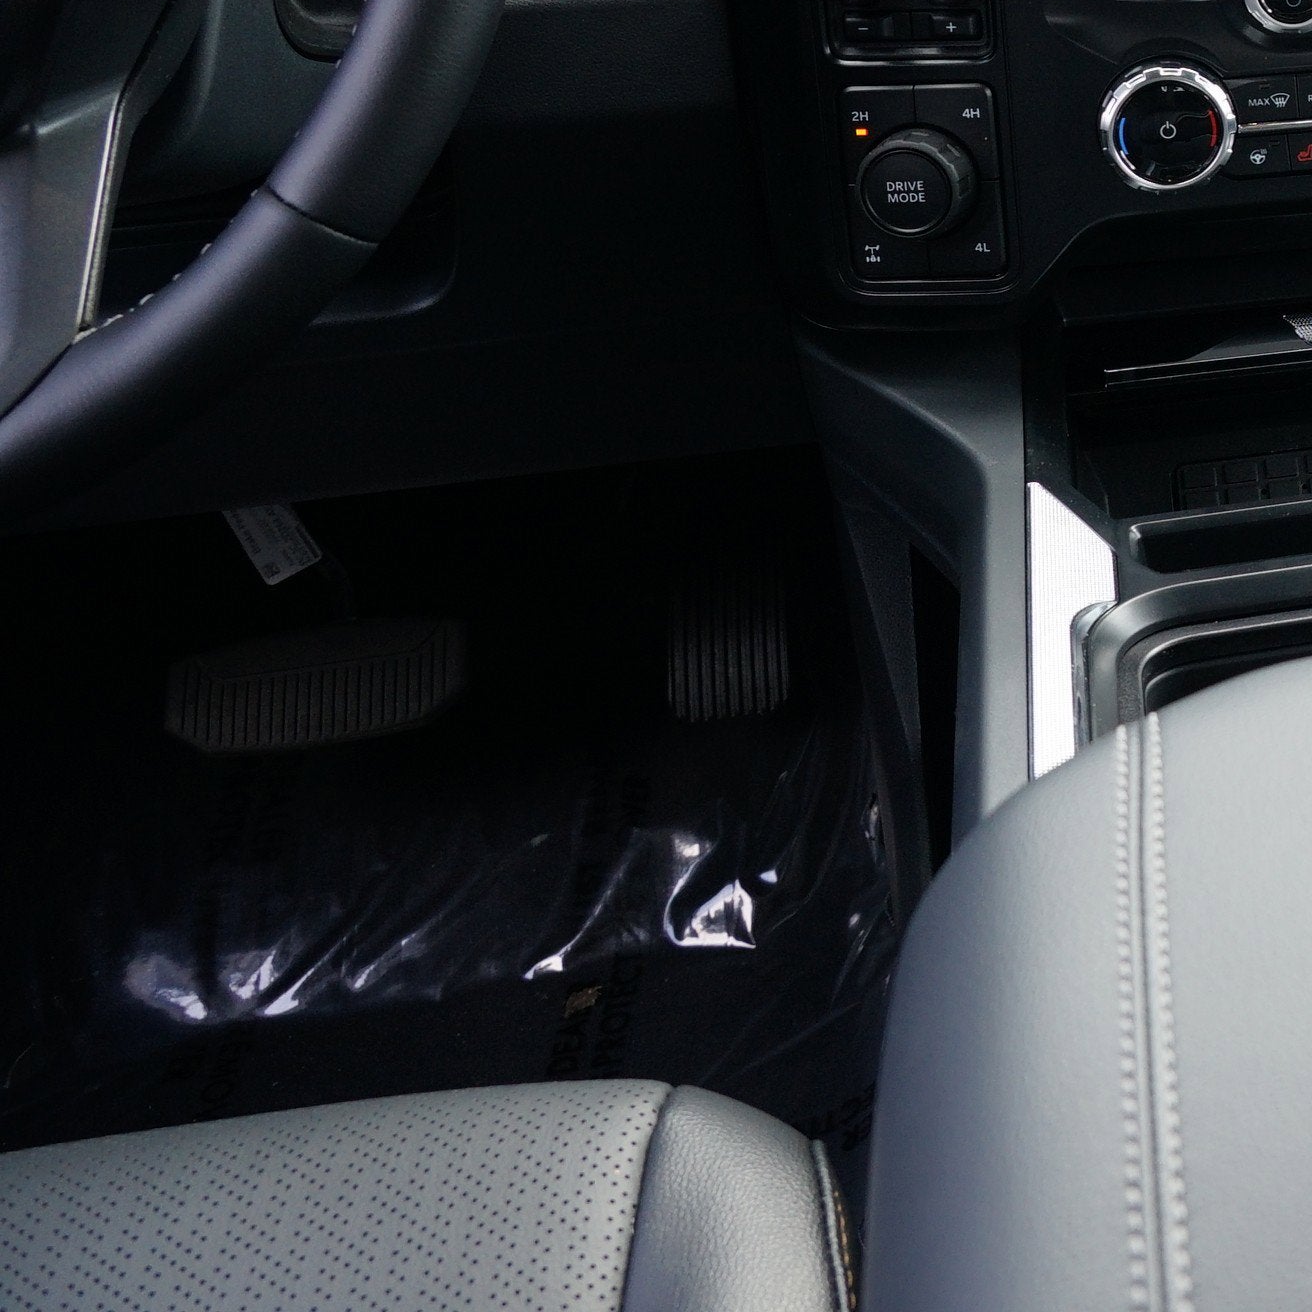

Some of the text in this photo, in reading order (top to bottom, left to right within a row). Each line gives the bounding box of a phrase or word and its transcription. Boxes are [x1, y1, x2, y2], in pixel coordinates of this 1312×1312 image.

[1249, 98, 1270, 107] MAX
[851, 111, 869, 122] 2H
[962, 108, 980, 119] 4H
[886, 180, 924, 192] DRIVE
[887, 192, 926, 203] MODE
[975, 242, 991, 253] 4L
